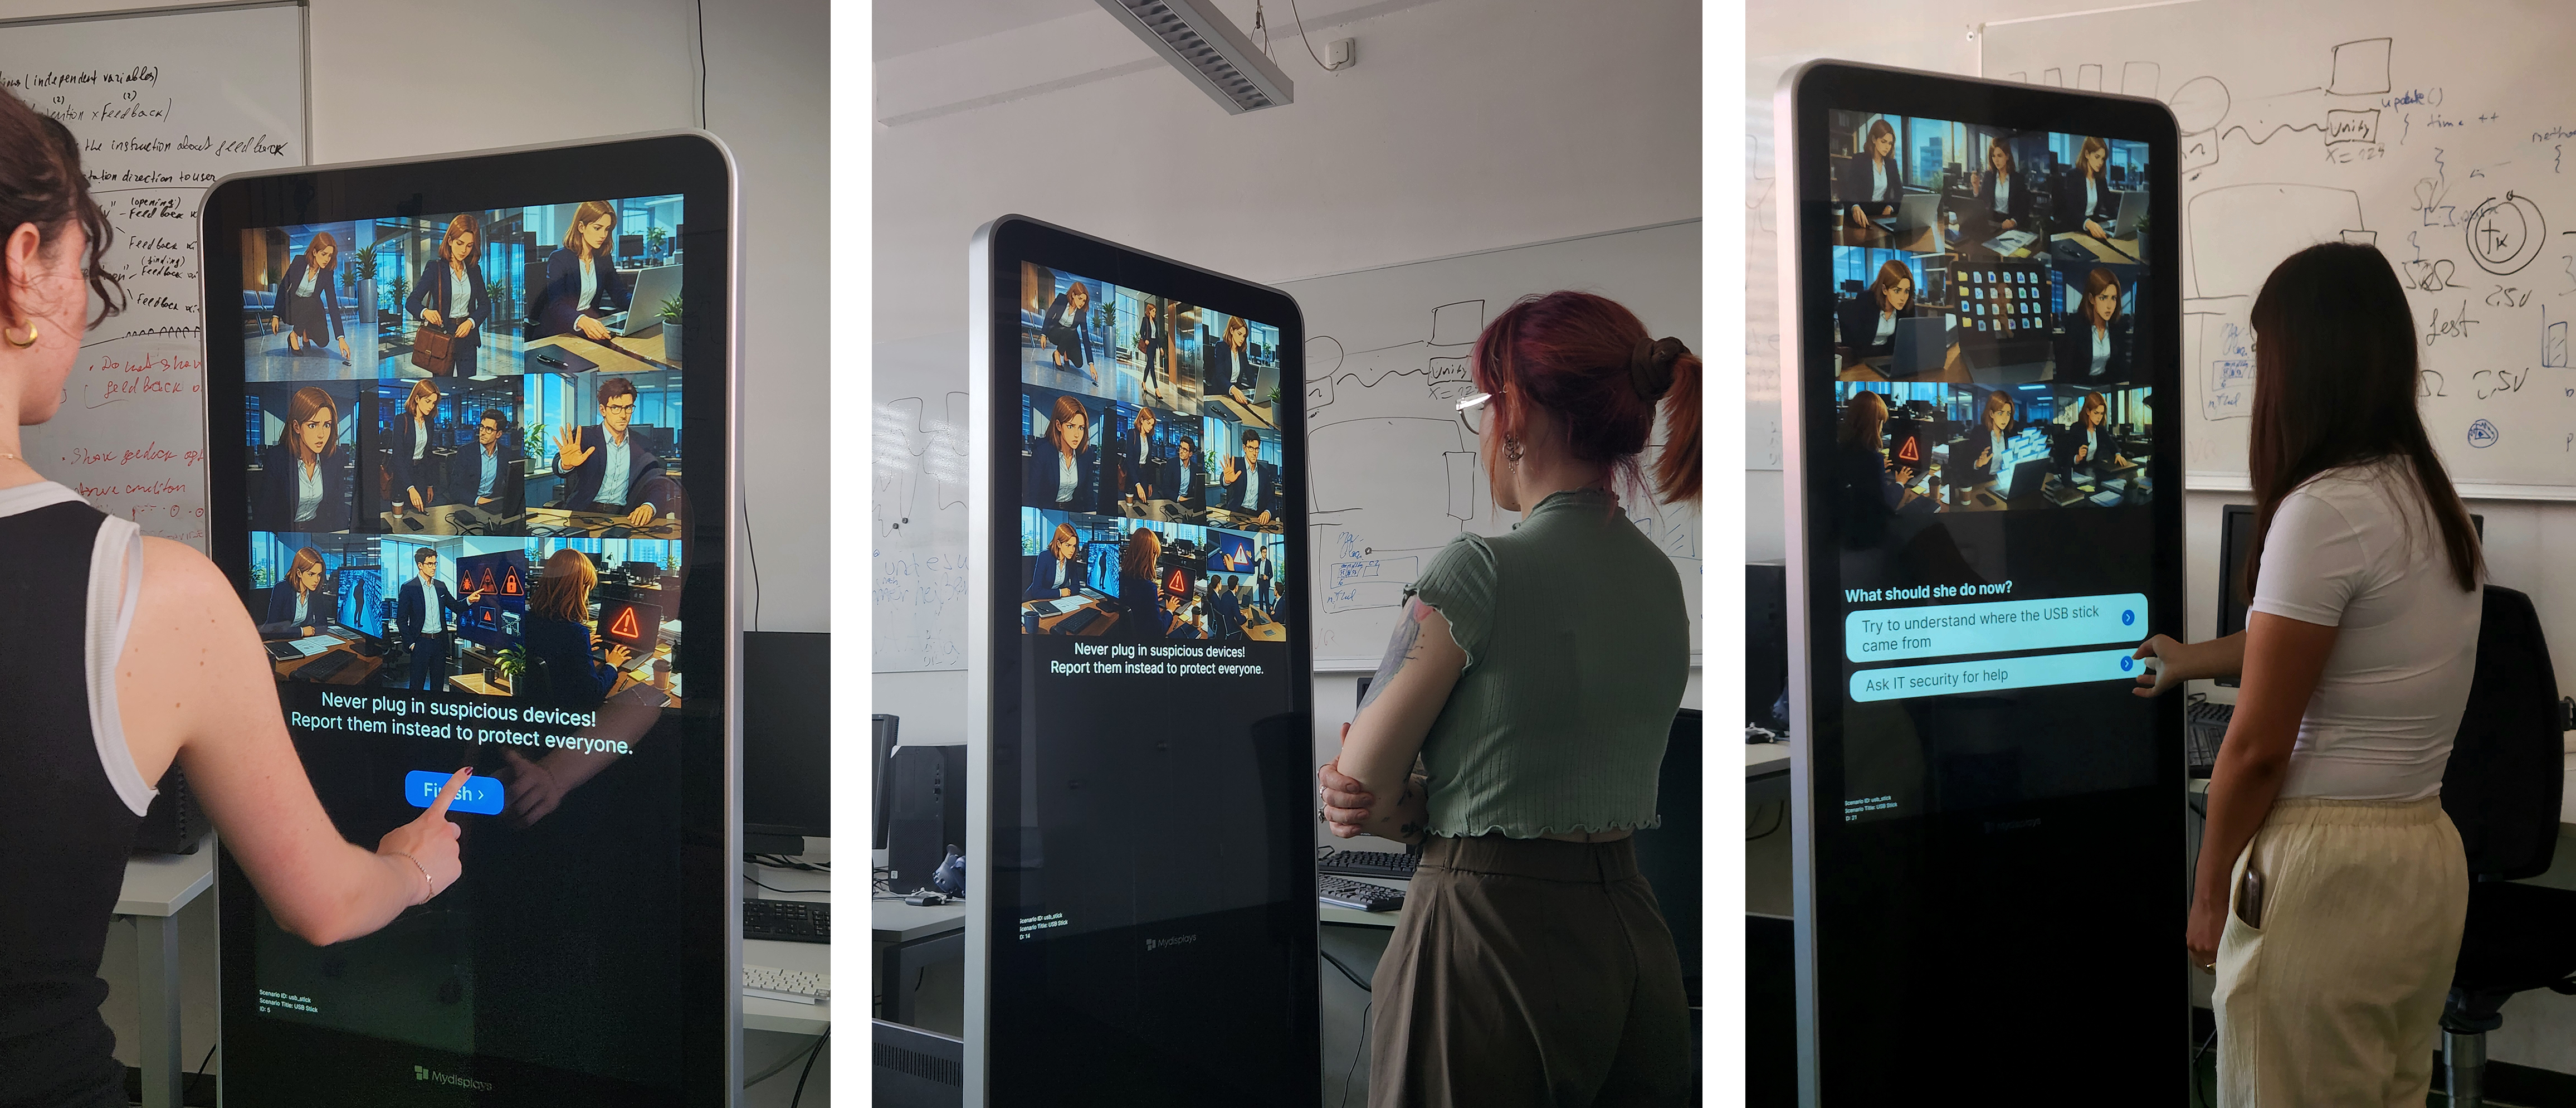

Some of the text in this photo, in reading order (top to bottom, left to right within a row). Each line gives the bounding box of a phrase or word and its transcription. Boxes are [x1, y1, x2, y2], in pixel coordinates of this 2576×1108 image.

[2330, 119, 2369, 139] Unity
[85, 138, 102, 152] the
[111, 137, 171, 152] instruction
[177, 134, 213, 150] about
[122, 169, 173, 184] direction
[1431, 364, 1467, 379] Unity
[1845, 580, 2013, 603] What should she do now?
[1862, 605, 2099, 635] Try to understand where the USB stick
[1074, 642, 1246, 659] Never plug in suspicious devices!
[1862, 637, 1932, 653] came from
[1051, 660, 1264, 677] Report them instead to protect everyone.
[1866, 669, 2008, 692] Ask IT security for help
[321, 692, 596, 727] Never plug in suspicious devices!
[291, 711, 633, 755] Report them instead to protect everyone.
[1157, 934, 1197, 949] Mydisplays
[259, 989, 280, 998] Scenario
[289, 994, 311, 1003] usb_stick
[259, 997, 280, 1006] Scenario
[432, 1071, 493, 1092] Mydisplays
